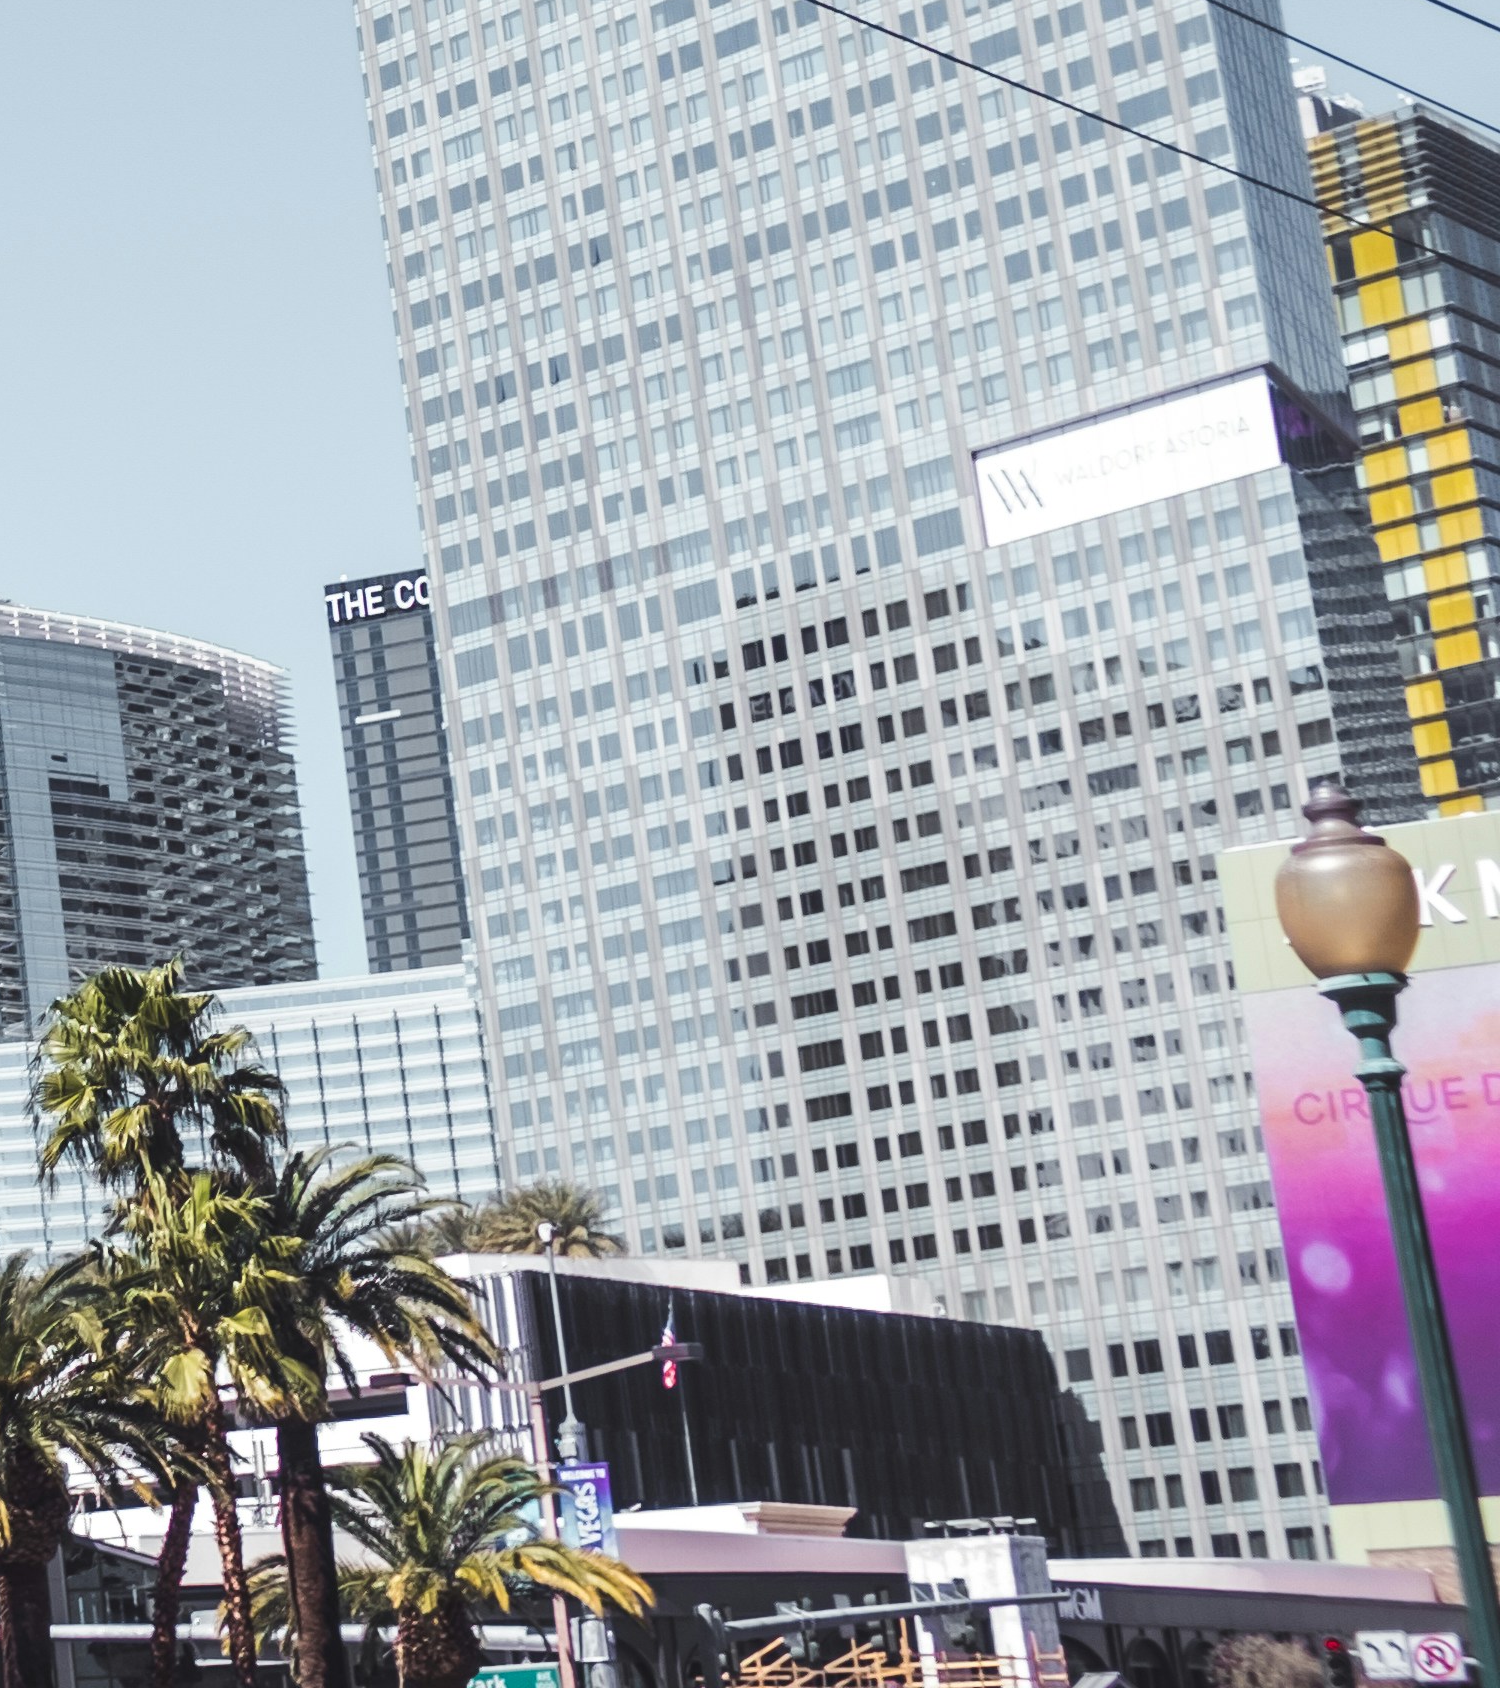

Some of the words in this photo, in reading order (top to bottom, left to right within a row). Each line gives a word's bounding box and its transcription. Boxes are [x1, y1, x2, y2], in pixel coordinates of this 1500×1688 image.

[1165, 415, 1252, 455] ASTORIA
[324, 584, 386, 623] THE
[1293, 1077, 1468, 1125] CIRUE
